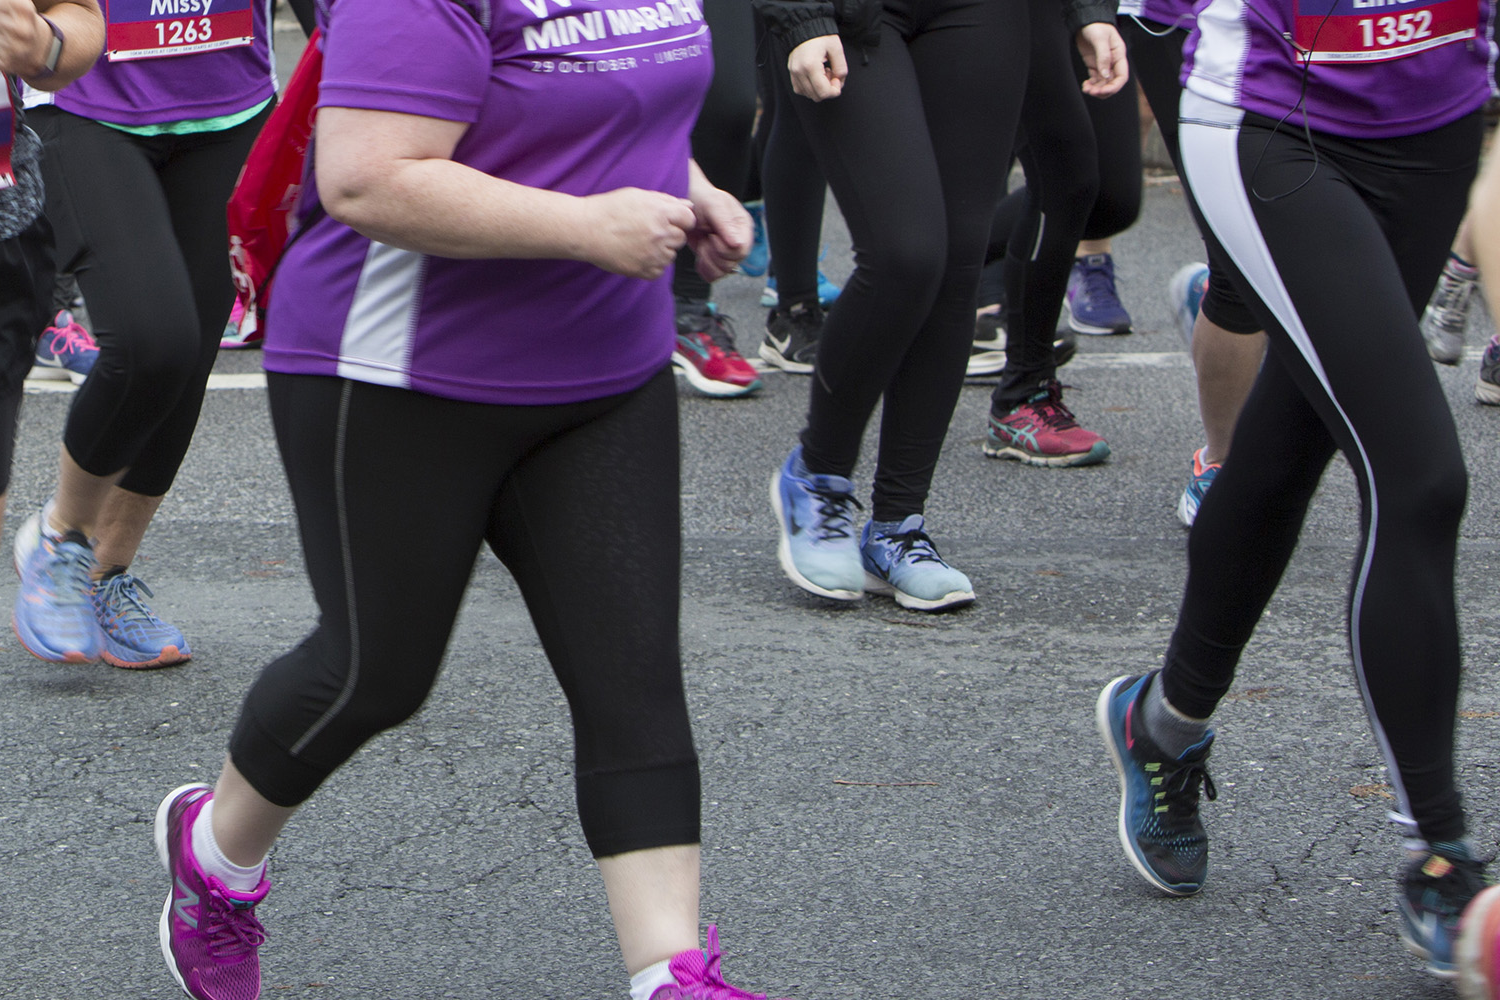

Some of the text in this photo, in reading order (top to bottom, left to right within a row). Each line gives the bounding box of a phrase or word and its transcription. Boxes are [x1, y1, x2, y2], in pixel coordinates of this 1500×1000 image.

[155, 18, 212, 45] 1263
[522, 10, 607, 51] MINI
[1357, 10, 1433, 47] 1352
[530, 60, 554, 72] 29
[558, 57, 638, 73] OCTOBER
